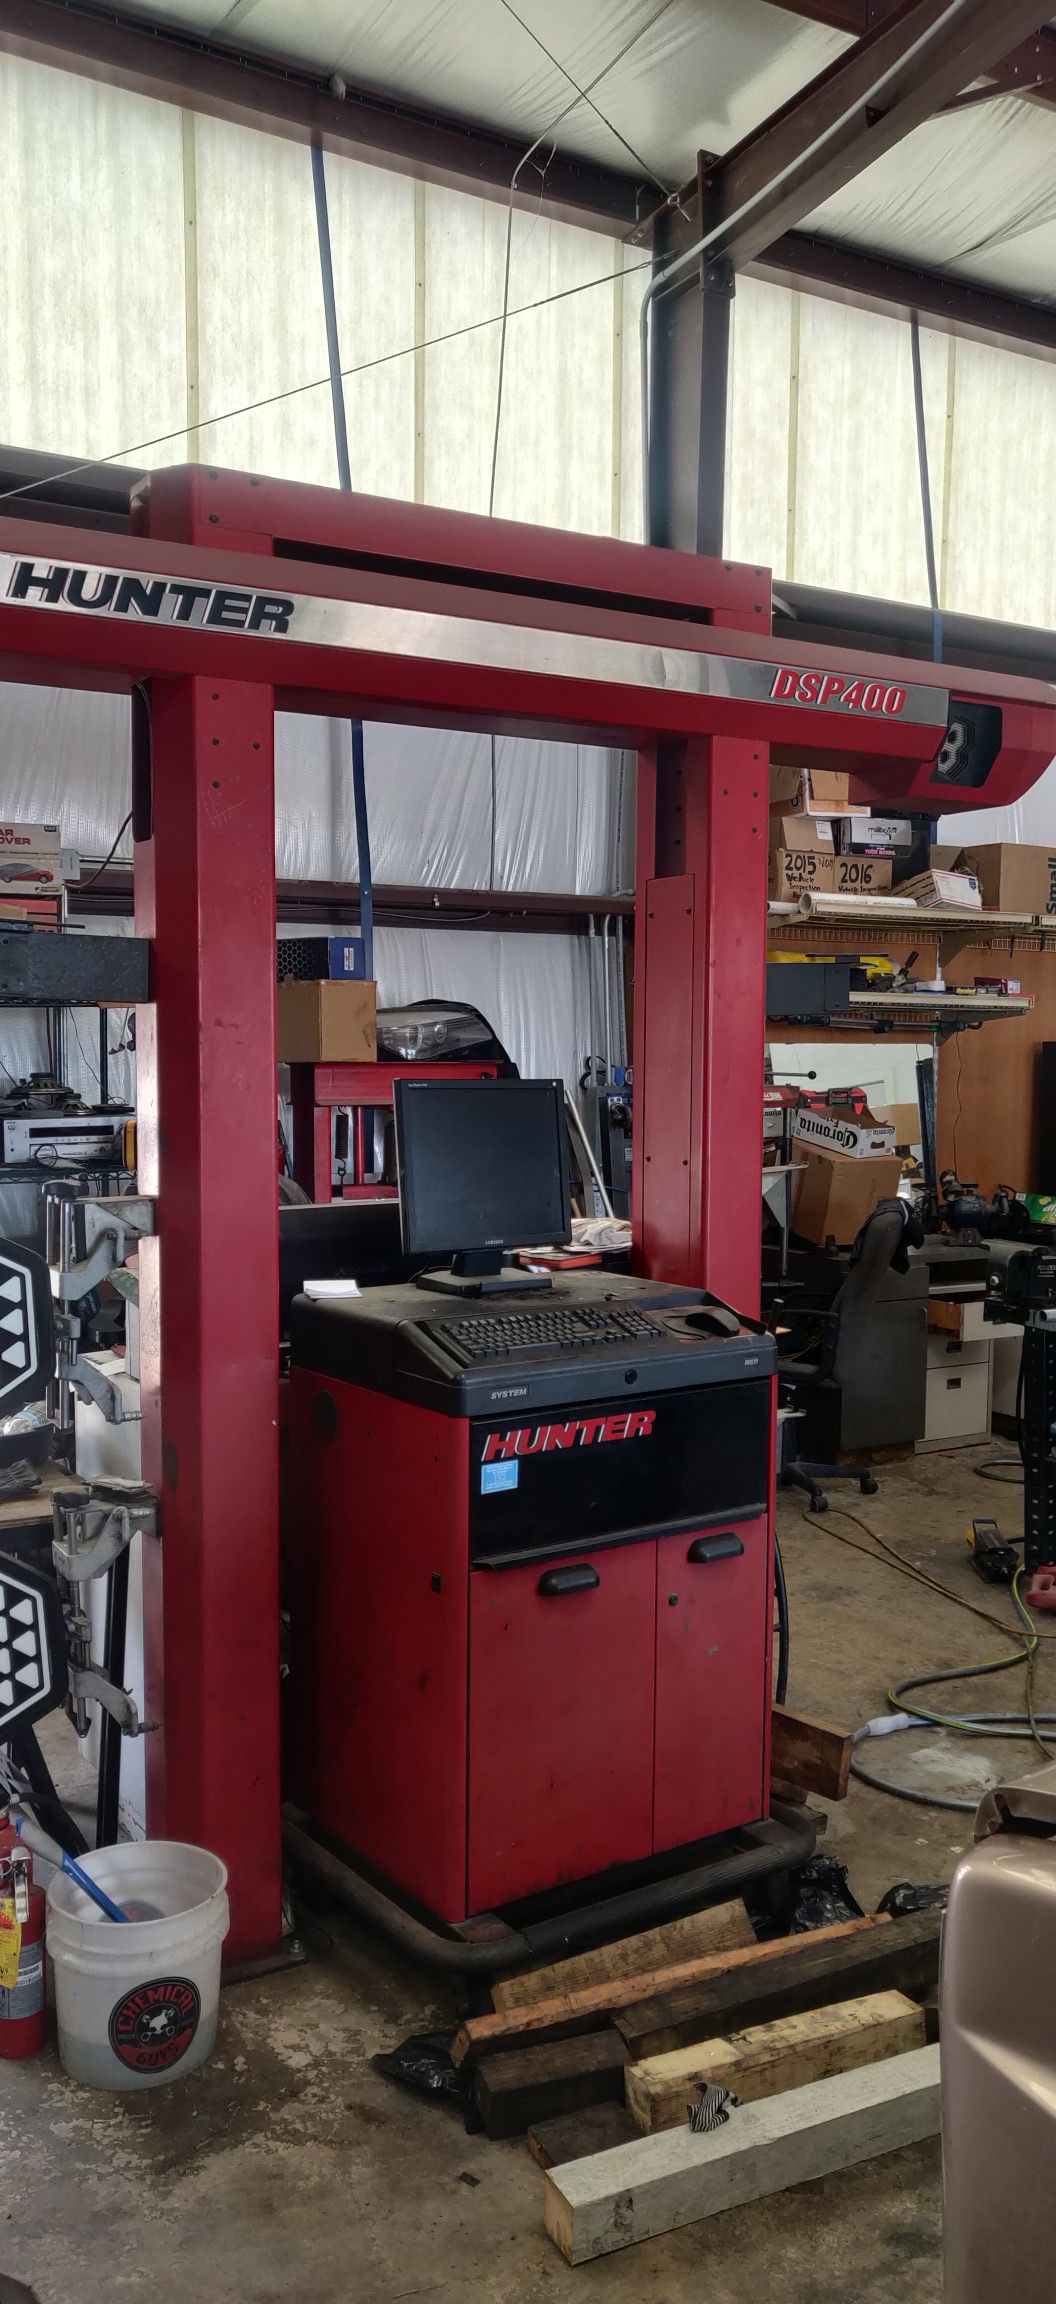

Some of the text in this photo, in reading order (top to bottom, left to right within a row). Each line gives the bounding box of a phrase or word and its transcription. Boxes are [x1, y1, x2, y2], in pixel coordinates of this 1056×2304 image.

[6, 560, 295, 634] HUNTER
[770, 669, 907, 715] DSP400
[784, 853, 817, 875] 2015
[839, 861, 873, 884] 2016
[788, 882, 821, 893] Inspection
[800, 1116, 858, 1149] Coronita
[490, 1387, 527, 1400] SYSTEM
[481, 1410, 656, 1461] HUNTER
[116, 1983, 196, 2032] CHEMICAL
